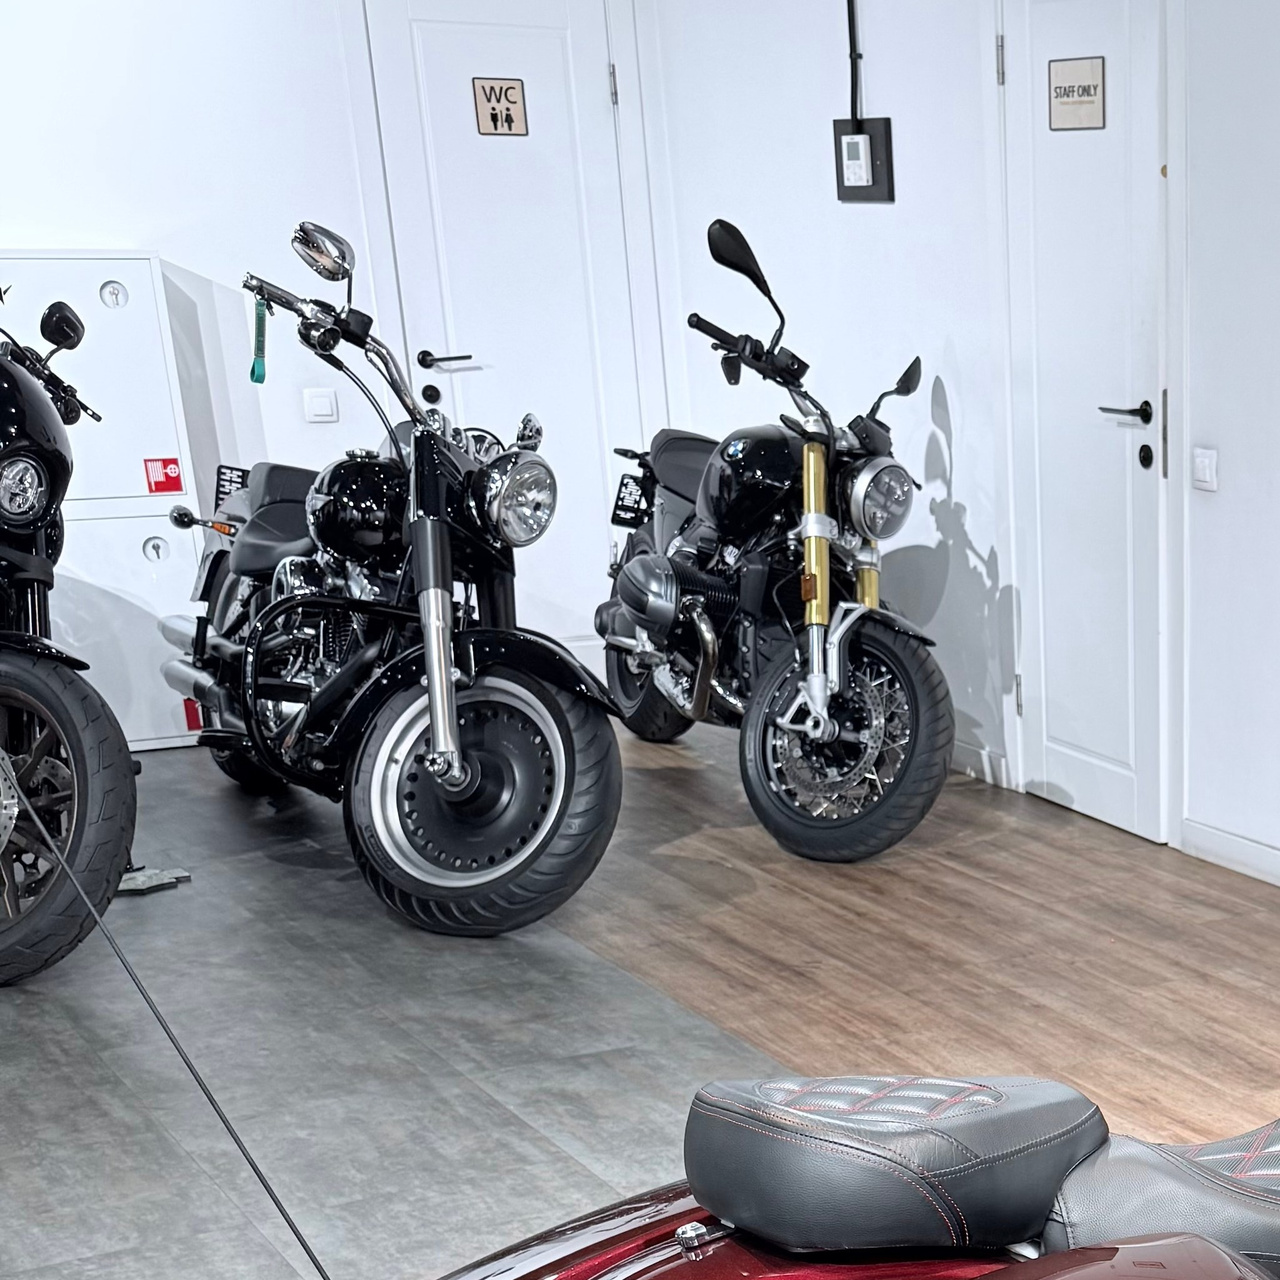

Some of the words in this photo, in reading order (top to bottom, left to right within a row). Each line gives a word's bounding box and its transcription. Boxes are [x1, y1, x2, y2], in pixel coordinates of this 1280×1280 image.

[481, 85, 517, 104] WC
[1054, 85, 1075, 98] STAFF
[1077, 84, 1098, 97] ONLY
